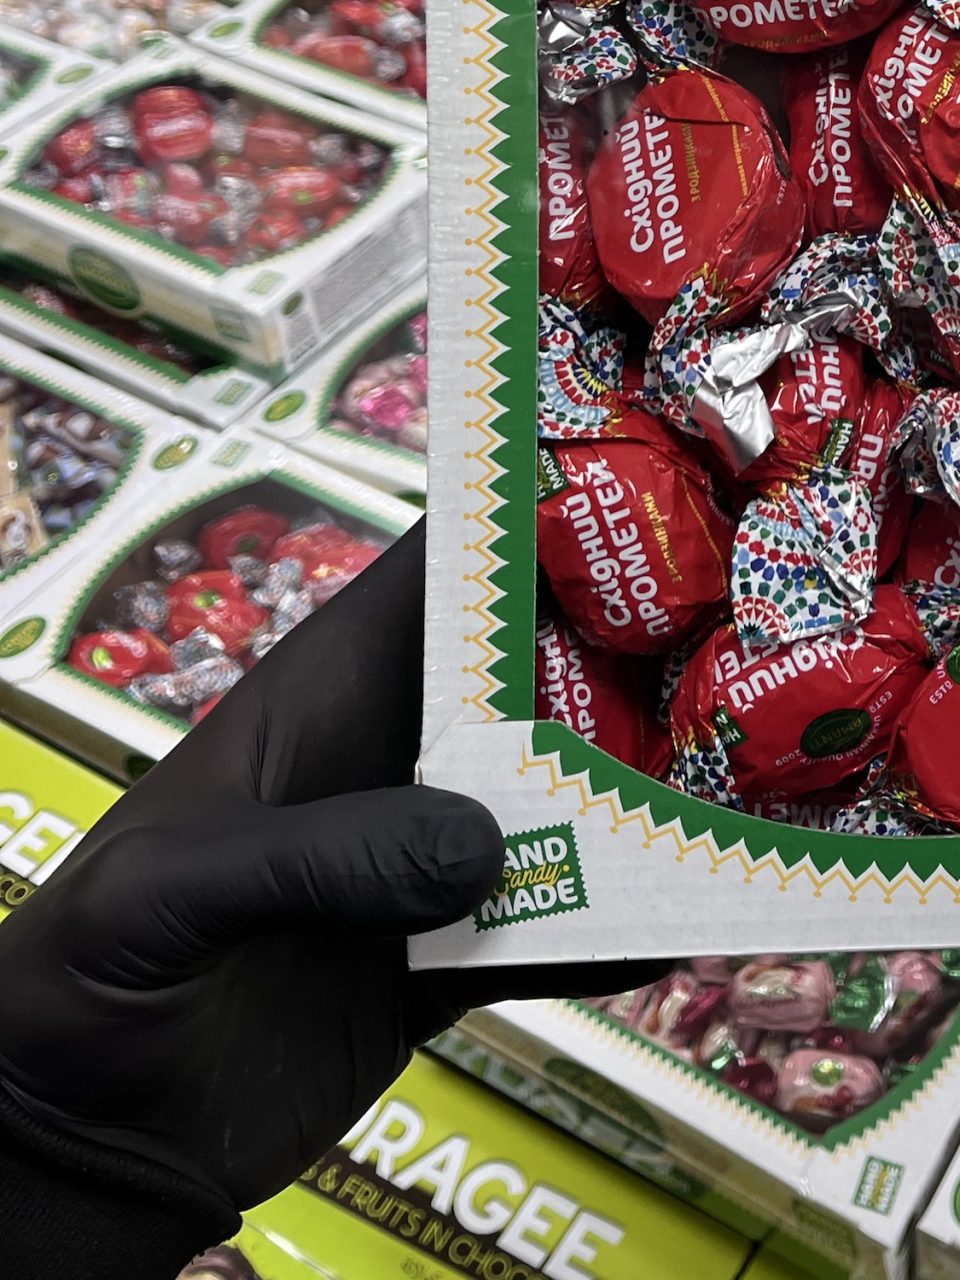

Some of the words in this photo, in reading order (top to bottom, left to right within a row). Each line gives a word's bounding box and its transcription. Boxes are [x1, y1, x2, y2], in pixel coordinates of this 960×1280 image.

[546, 113, 576, 242] ПРОМЕТ
[615, 119, 655, 253] Східний
[643, 108, 688, 265] ПРОМЕТЕ
[830, 45, 853, 208] ПРОМЕТЕ
[538, 447, 563, 490] MADE
[559, 492, 632, 628] Східний
[479, 877, 579, 922] MADE
[503, 836, 568, 871] AND
[336, 1173, 425, 1238] FRUITS
[416, 1218, 453, 1253] IN
[337, 1097, 626, 1280] RAGEE
